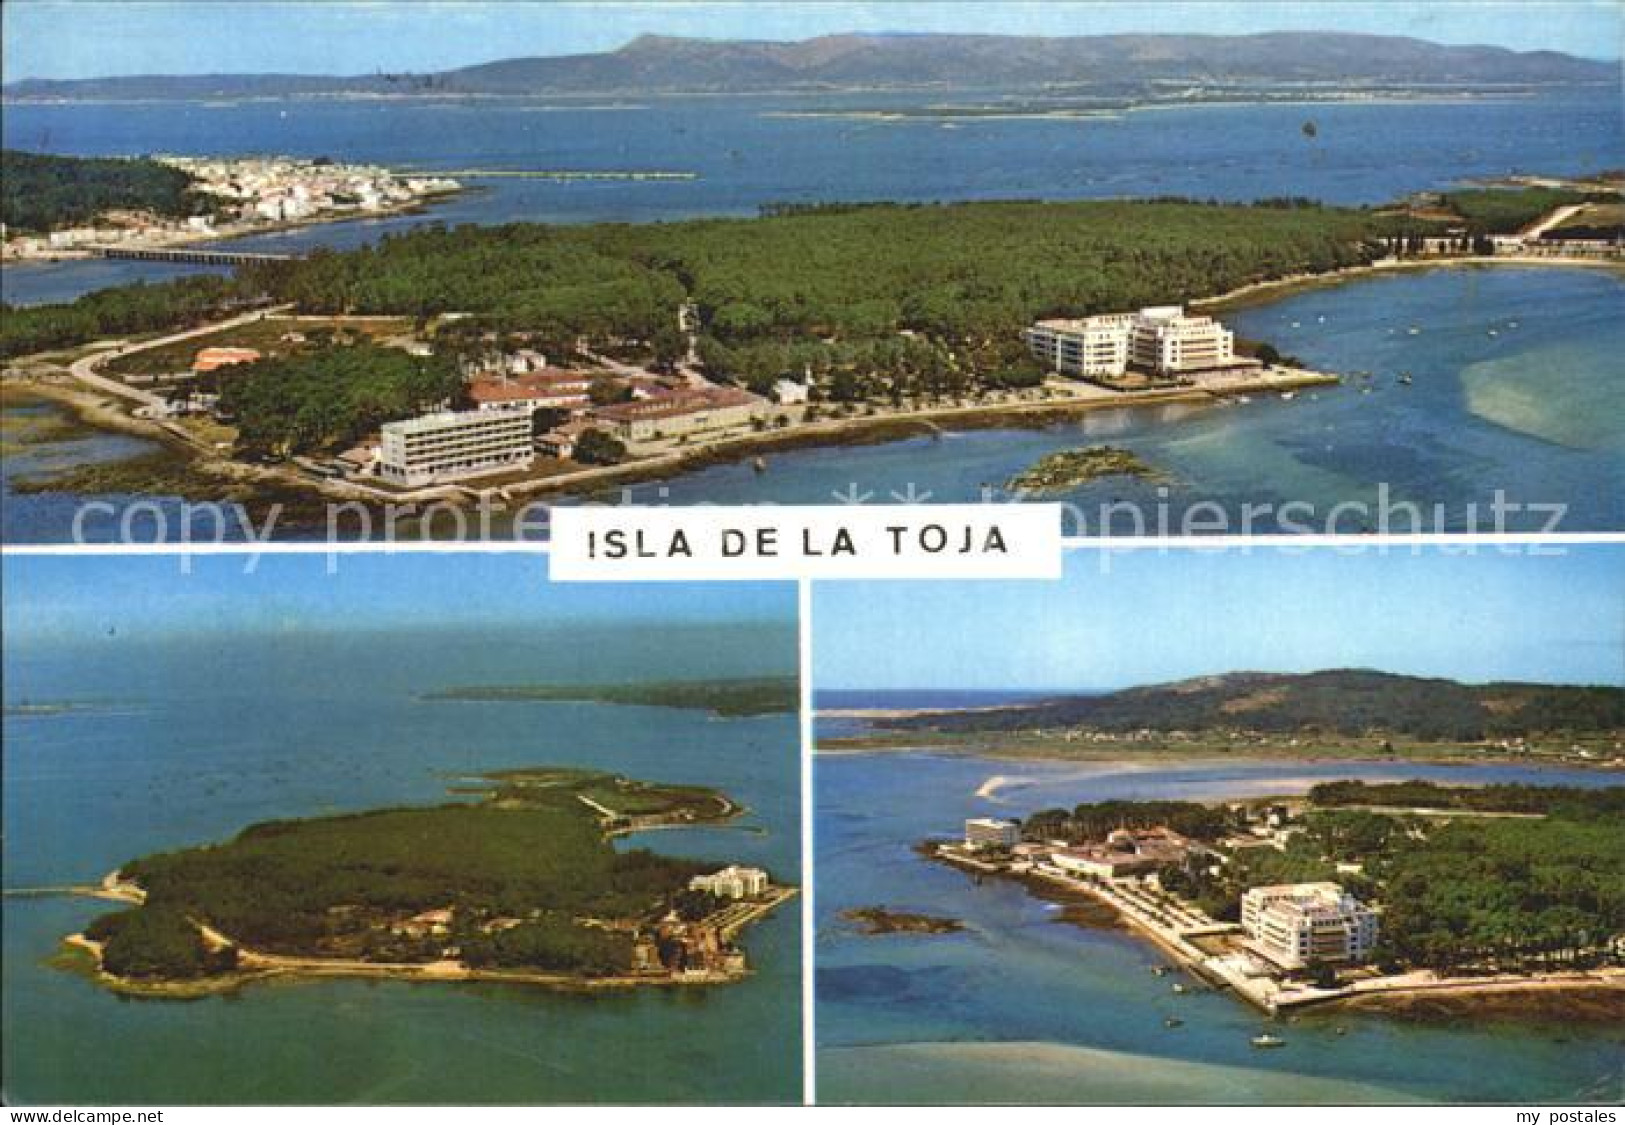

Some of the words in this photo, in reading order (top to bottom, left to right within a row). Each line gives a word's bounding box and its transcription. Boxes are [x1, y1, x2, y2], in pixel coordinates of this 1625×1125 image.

[588, 528, 693, 559] ISLA
[721, 527, 778, 558] DE
[802, 527, 856, 556] LA
[886, 524, 1008, 554] TOJA
